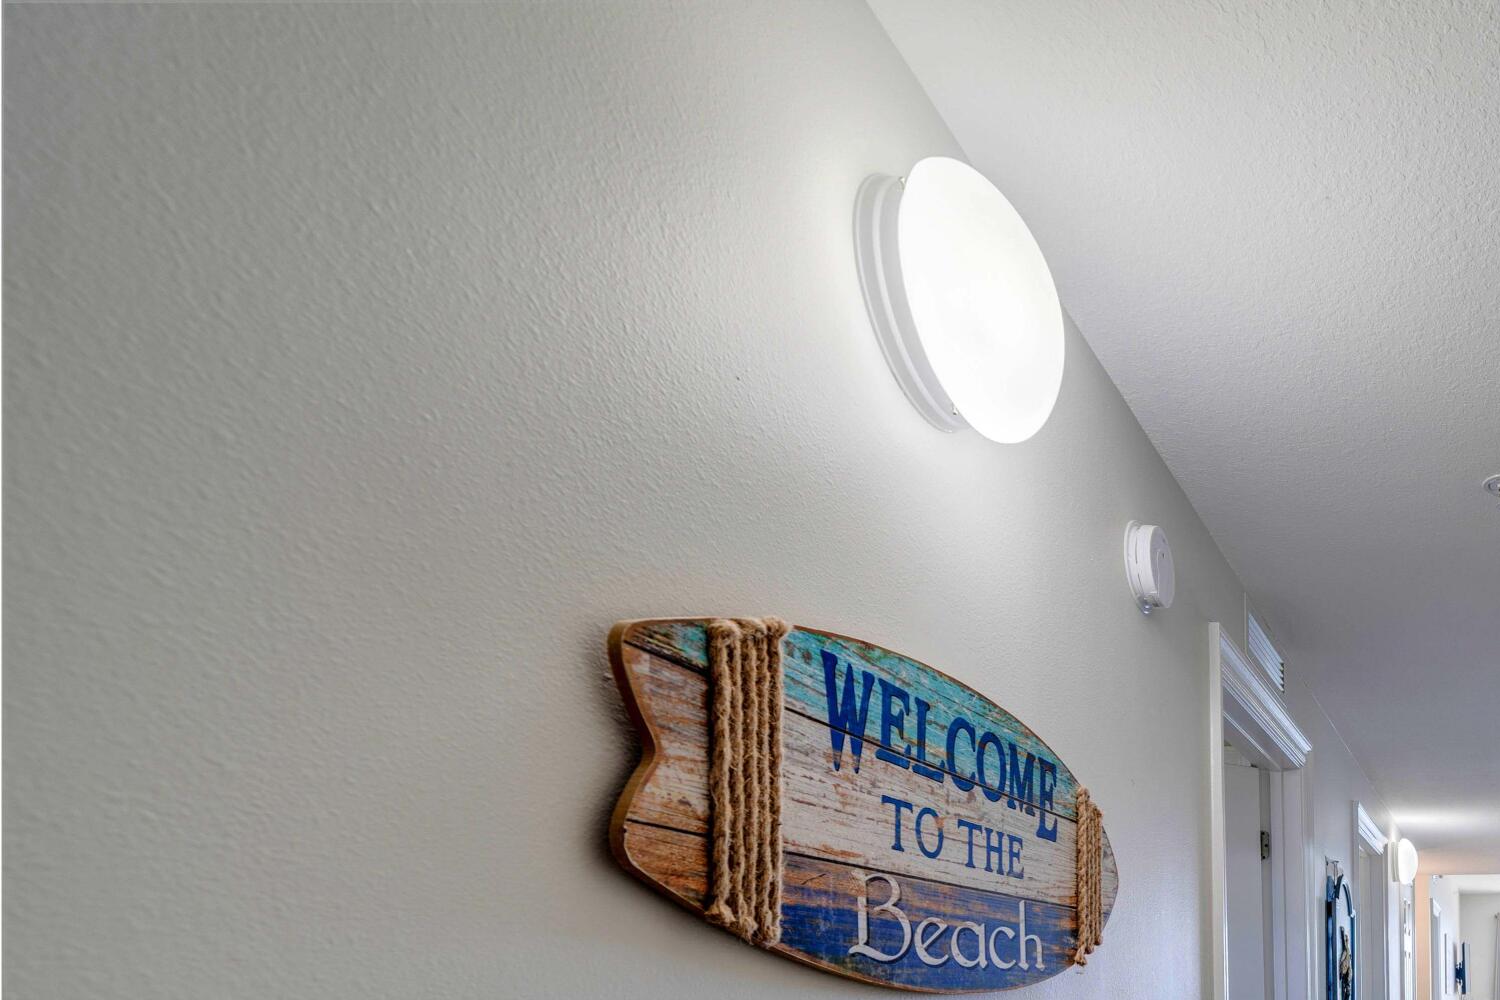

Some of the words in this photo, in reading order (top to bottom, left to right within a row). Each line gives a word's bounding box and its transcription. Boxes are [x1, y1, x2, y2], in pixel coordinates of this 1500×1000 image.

[821, 650, 1057, 842] WELCOME
[881, 795, 944, 859] TO
[958, 819, 1024, 879] THE
[848, 871, 1045, 971] Beach
